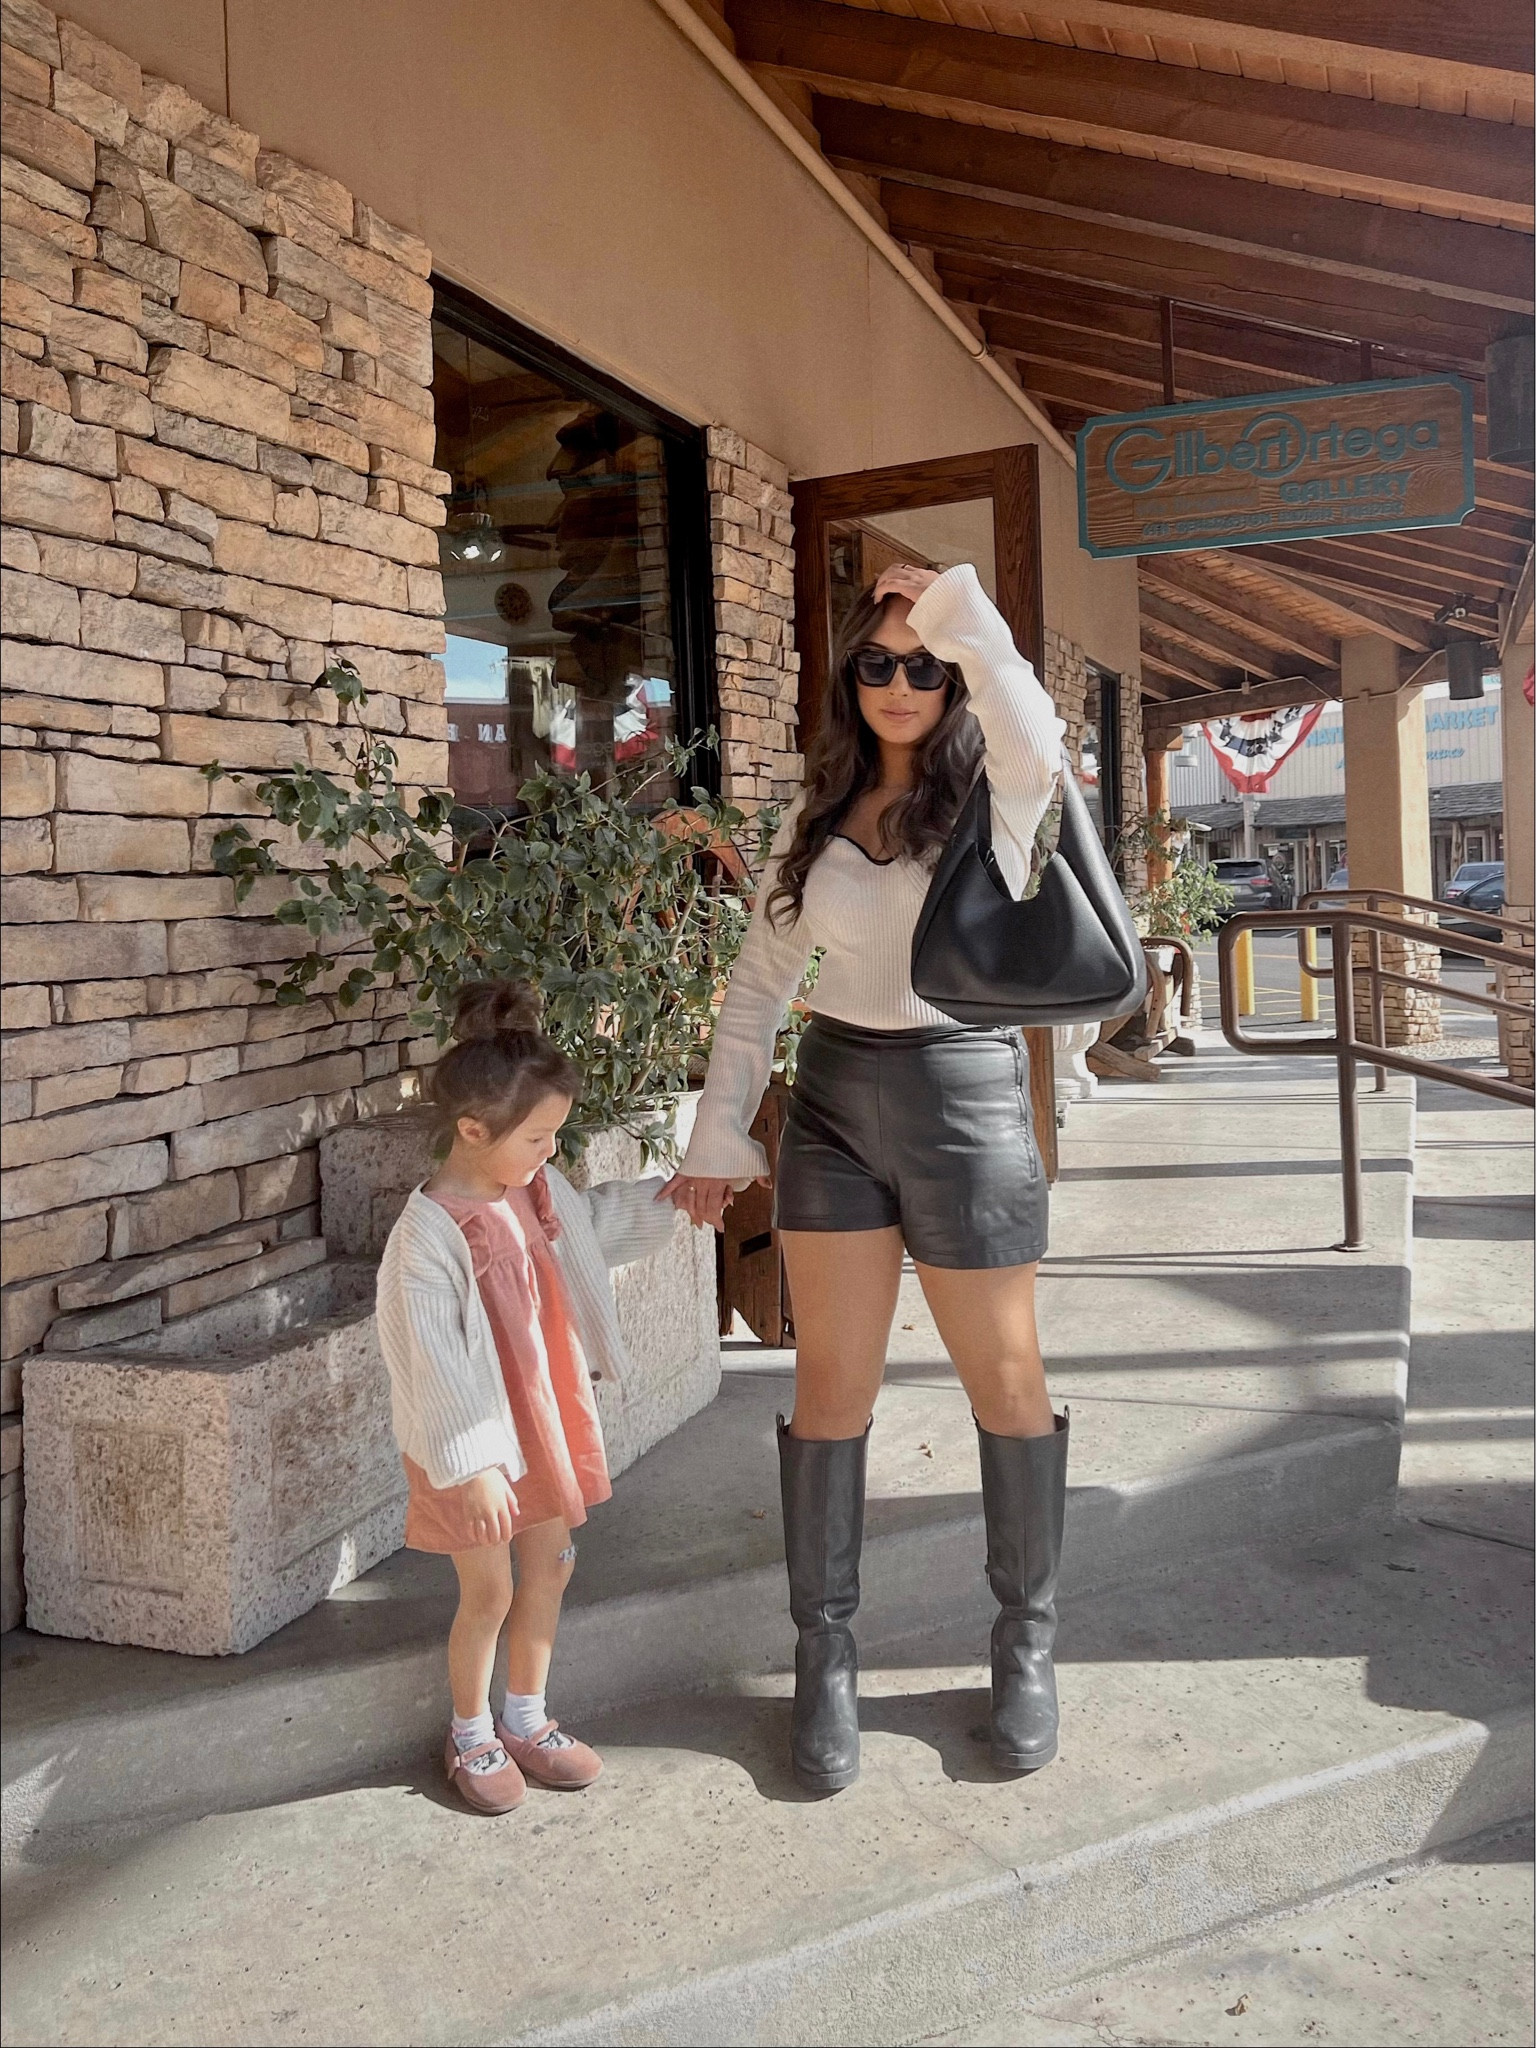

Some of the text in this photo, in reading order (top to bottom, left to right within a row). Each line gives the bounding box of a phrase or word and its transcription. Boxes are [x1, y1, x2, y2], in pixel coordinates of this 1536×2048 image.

[1106, 412, 1439, 493] Gilbert Ortega
[1279, 472, 1412, 504] GALLERY
